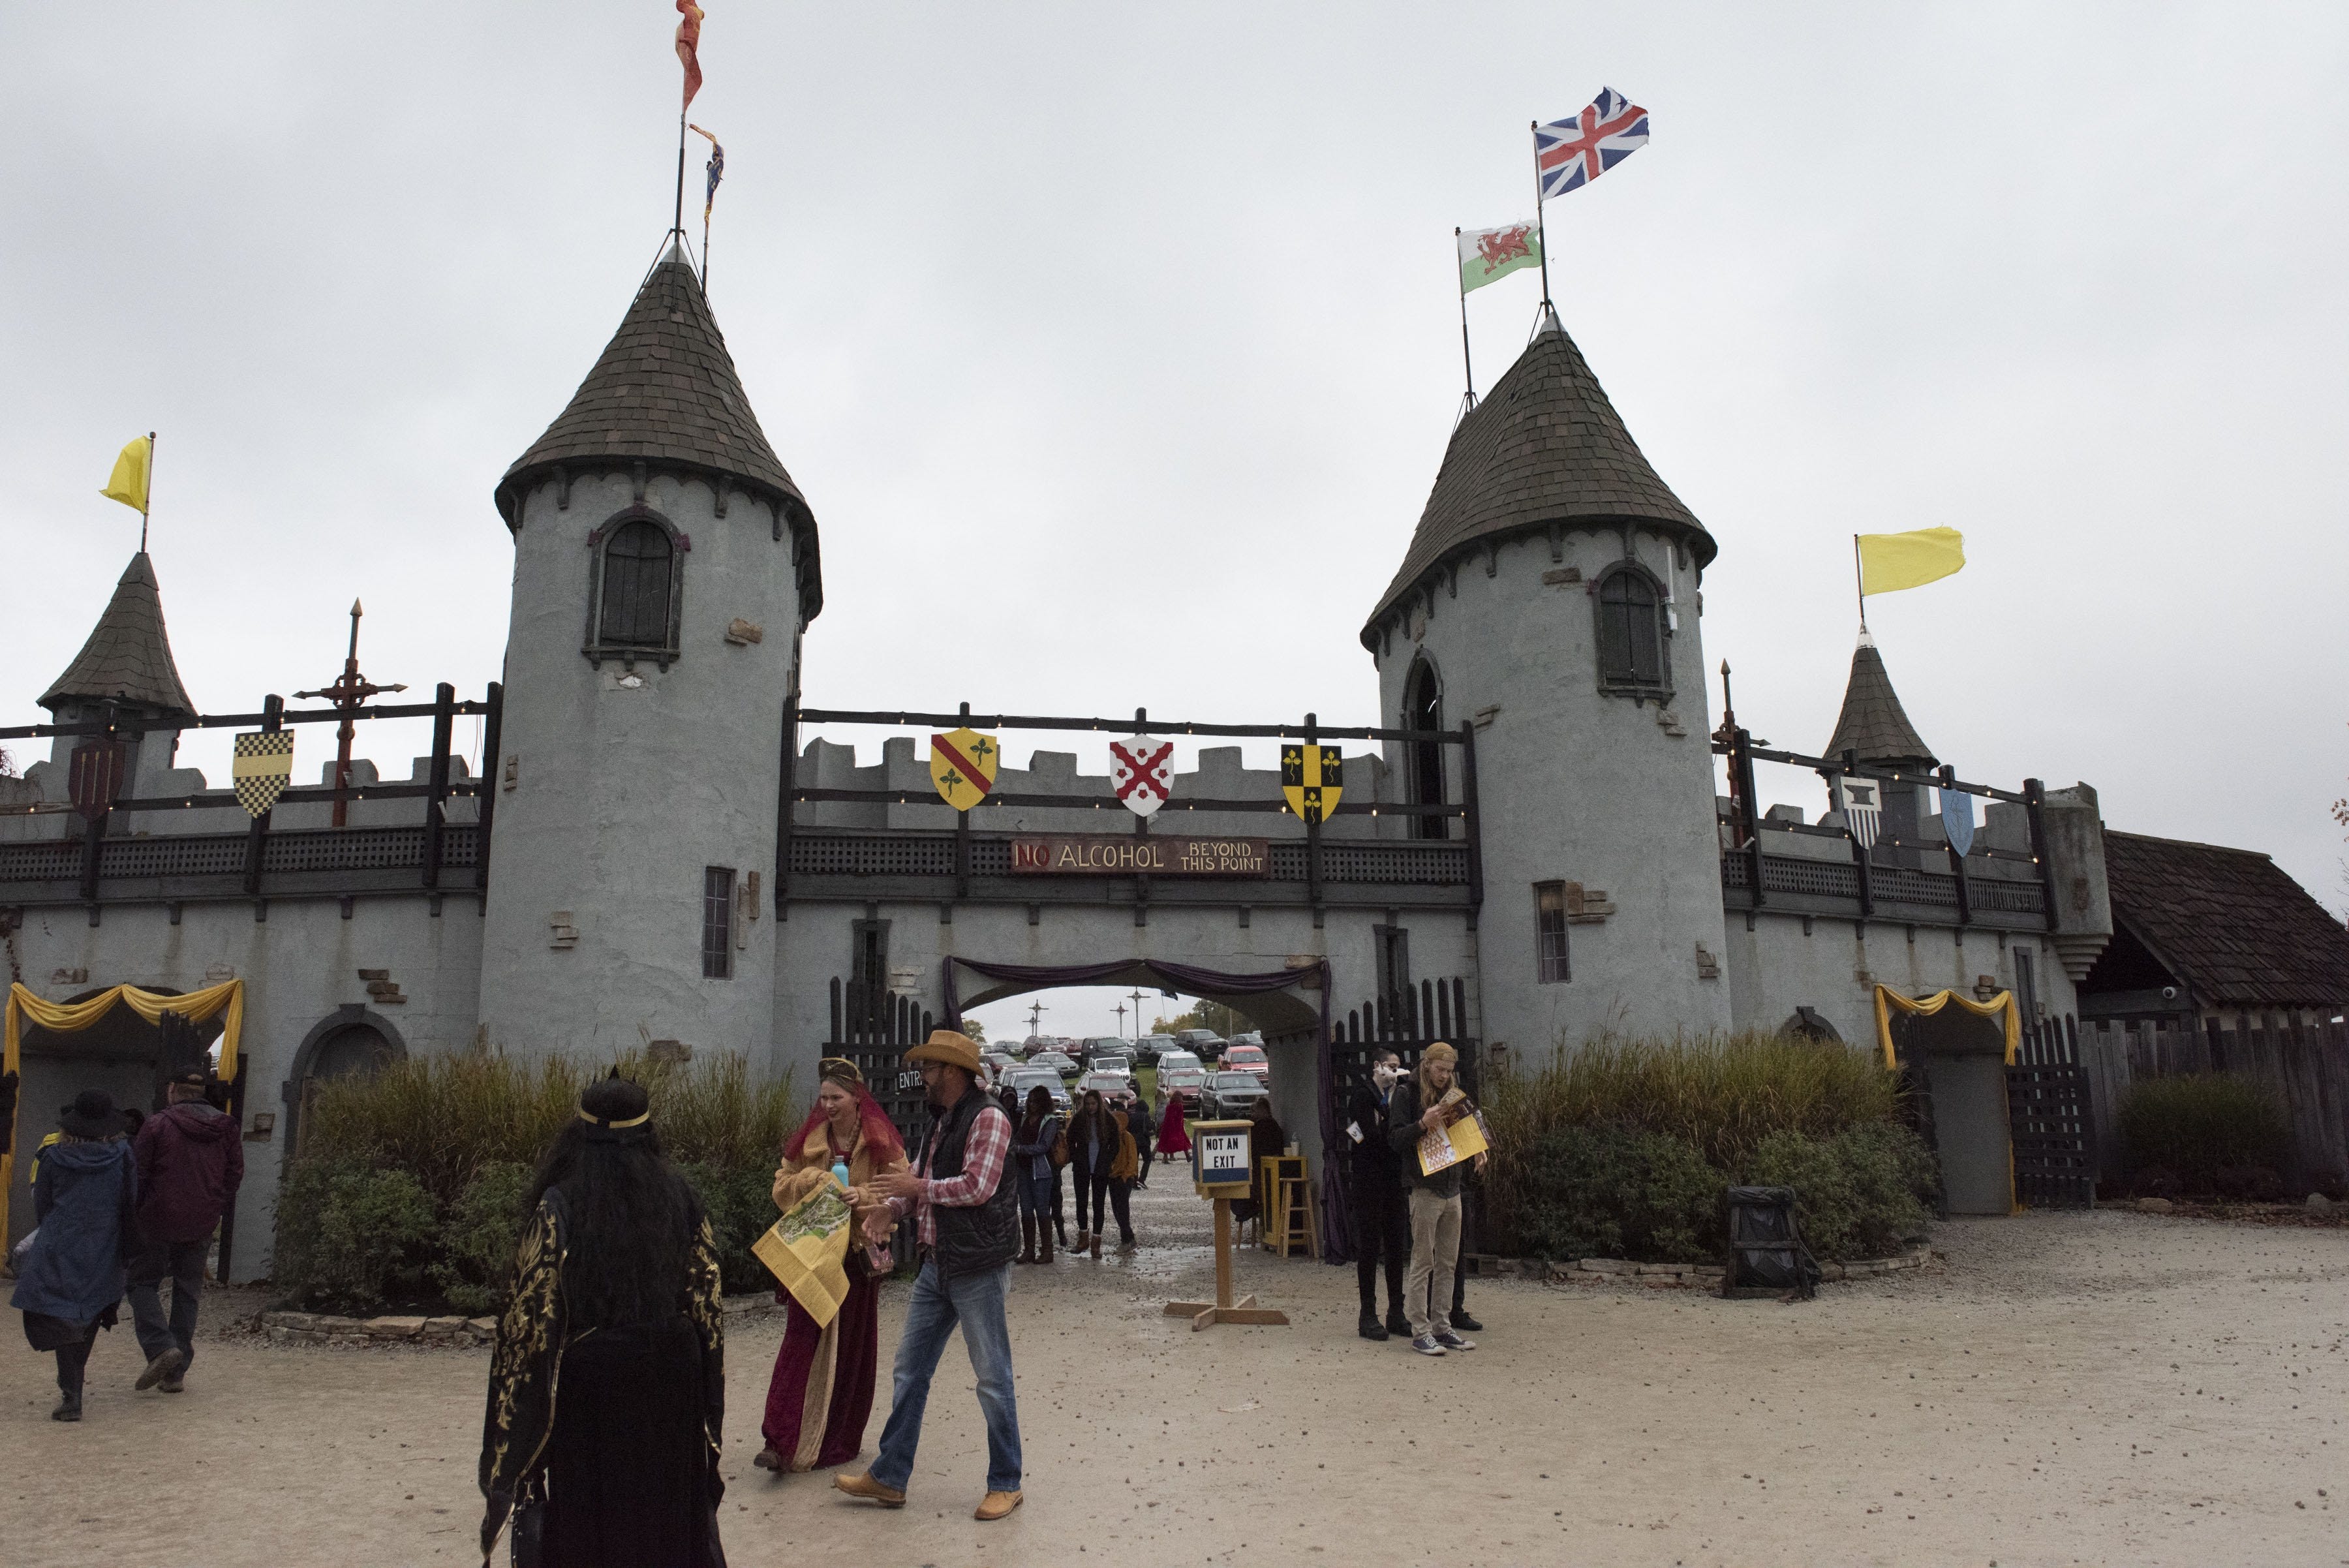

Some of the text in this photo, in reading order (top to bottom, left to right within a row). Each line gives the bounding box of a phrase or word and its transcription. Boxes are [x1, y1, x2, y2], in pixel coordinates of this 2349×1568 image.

[1015, 844, 1164, 867] NO ALCOHOL
[1190, 842, 1251, 857] BEYOND
[1181, 857, 1263, 870] THIS POINT
[899, 1070, 923, 1088] ENTR
[1206, 1137, 1238, 1150] NOT AN
[1214, 1156, 1235, 1168] EXIT
